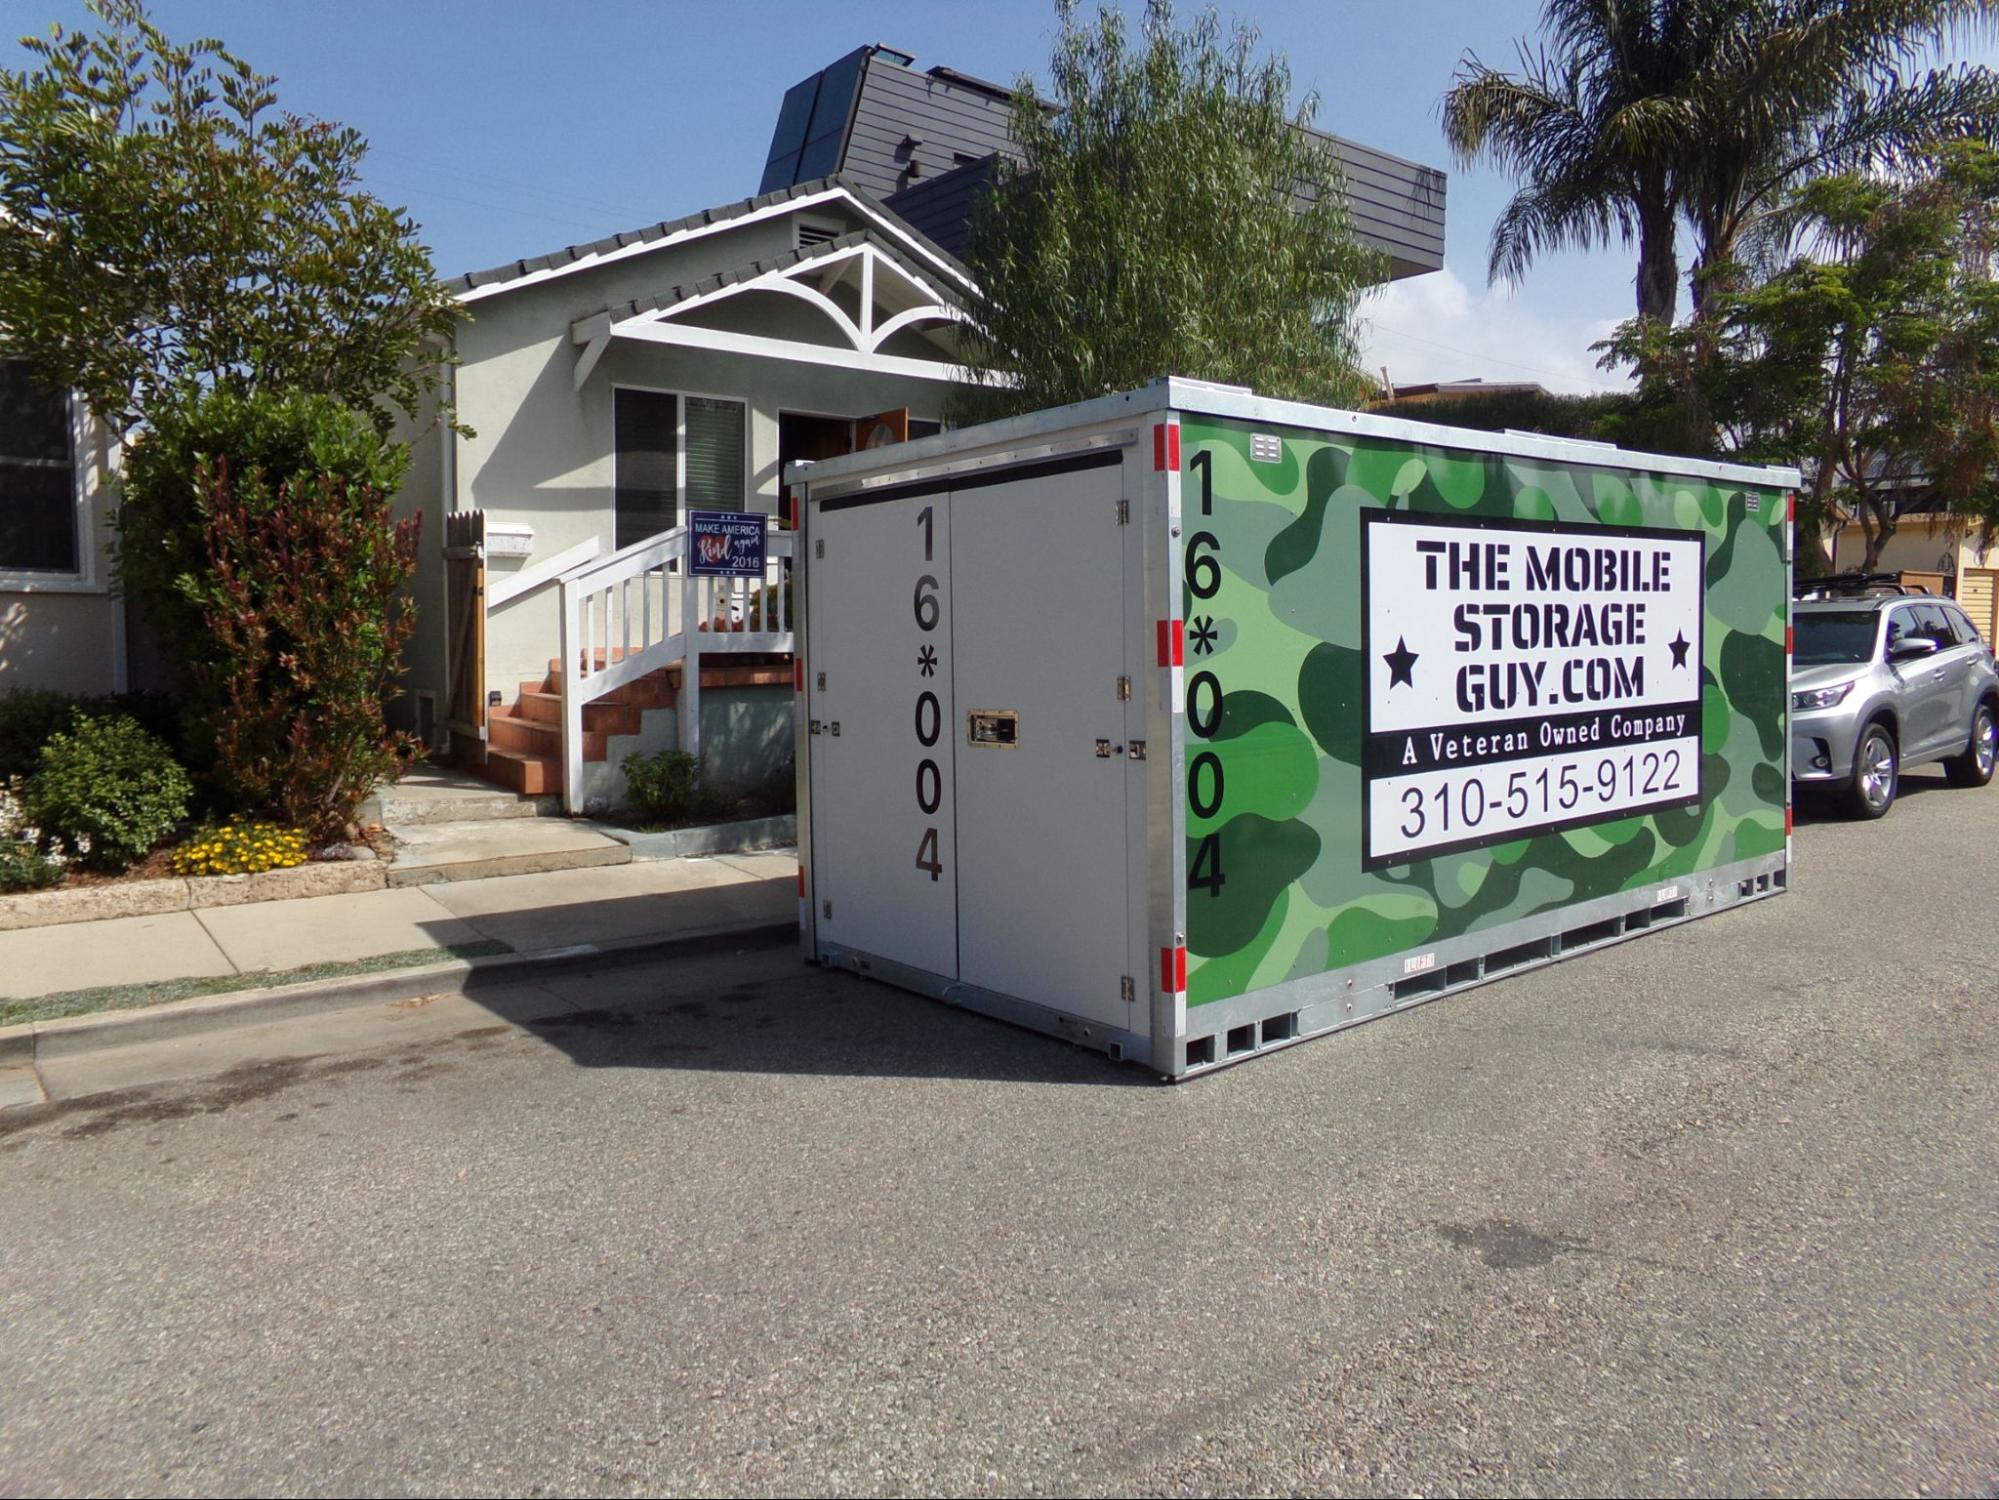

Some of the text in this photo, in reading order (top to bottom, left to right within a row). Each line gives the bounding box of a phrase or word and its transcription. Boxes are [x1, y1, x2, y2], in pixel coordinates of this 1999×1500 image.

[695, 523, 760, 535] MAKE AMERICA
[732, 556, 760, 568] 2016
[1416, 540, 1671, 592] THE MOBILE
[1453, 603, 1646, 652] STORAGE
[1456, 656, 1645, 712] GUY.COM
[1402, 712, 1686, 765] A Veteran Owned Company
[1400, 749, 1681, 839] 310-515-9122
